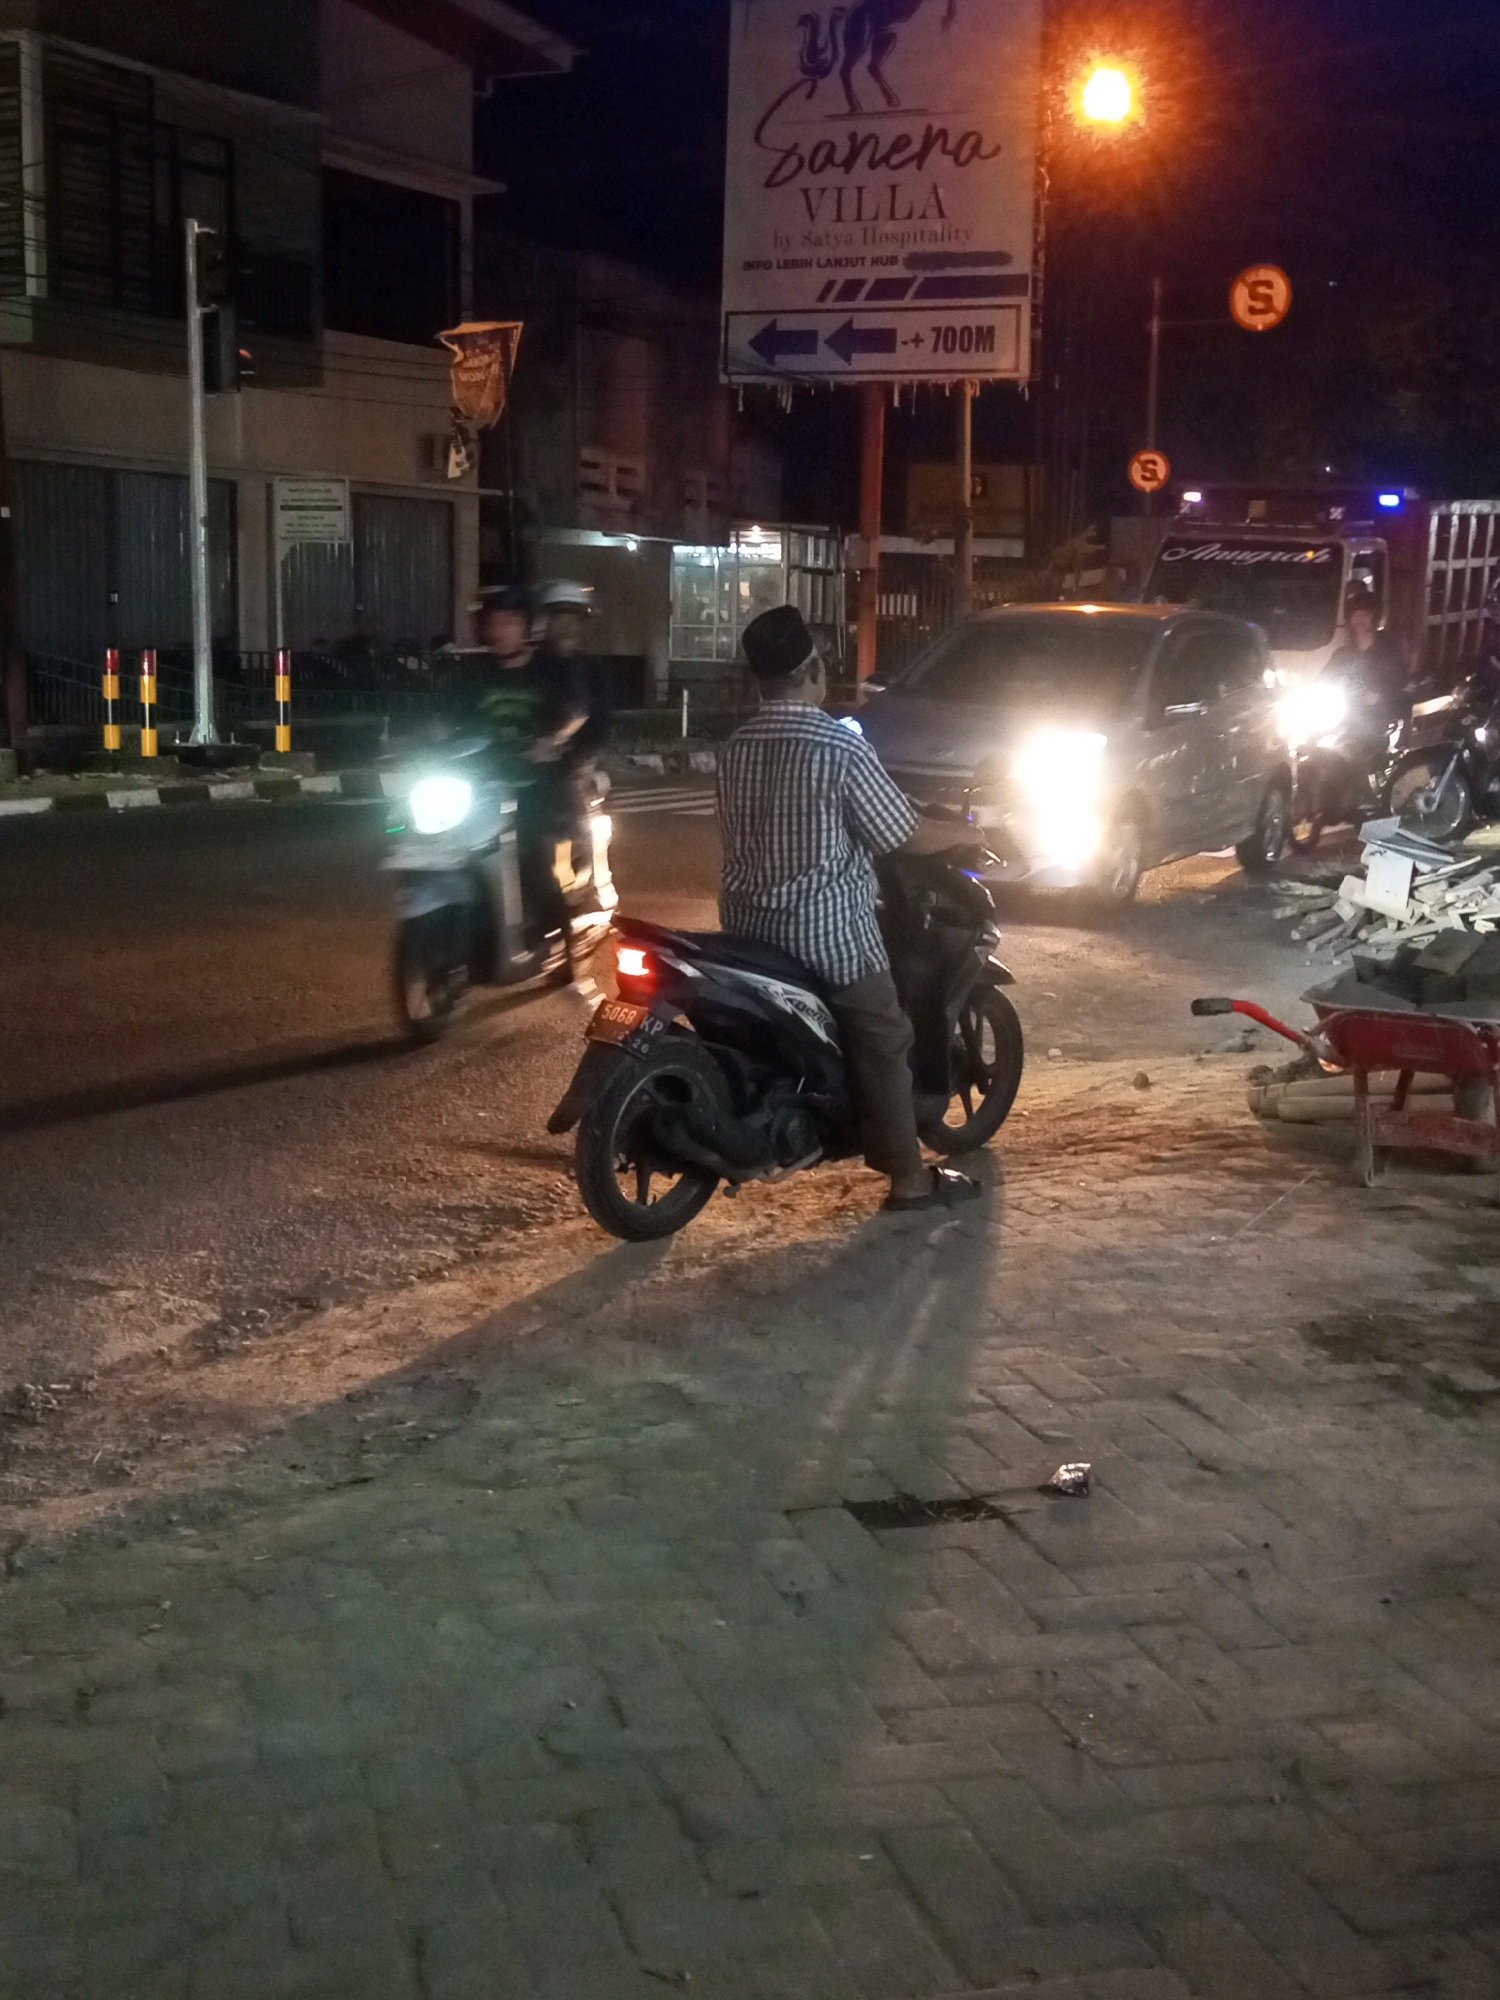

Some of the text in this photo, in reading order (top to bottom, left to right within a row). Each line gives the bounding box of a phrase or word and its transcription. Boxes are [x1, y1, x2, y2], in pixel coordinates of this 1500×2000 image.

[800, 183, 947, 224] VILLA
[862, 222, 973, 247] Hospitality
[816, 256, 866, 269] LANJUT
[1248, 280, 1275, 315] S
[931, 325, 996, 354] 700M
[1140, 459, 1159, 481] S
[601, 1003, 664, 1036] 5068 KP
[632, 1038, 650, 1054] 26
